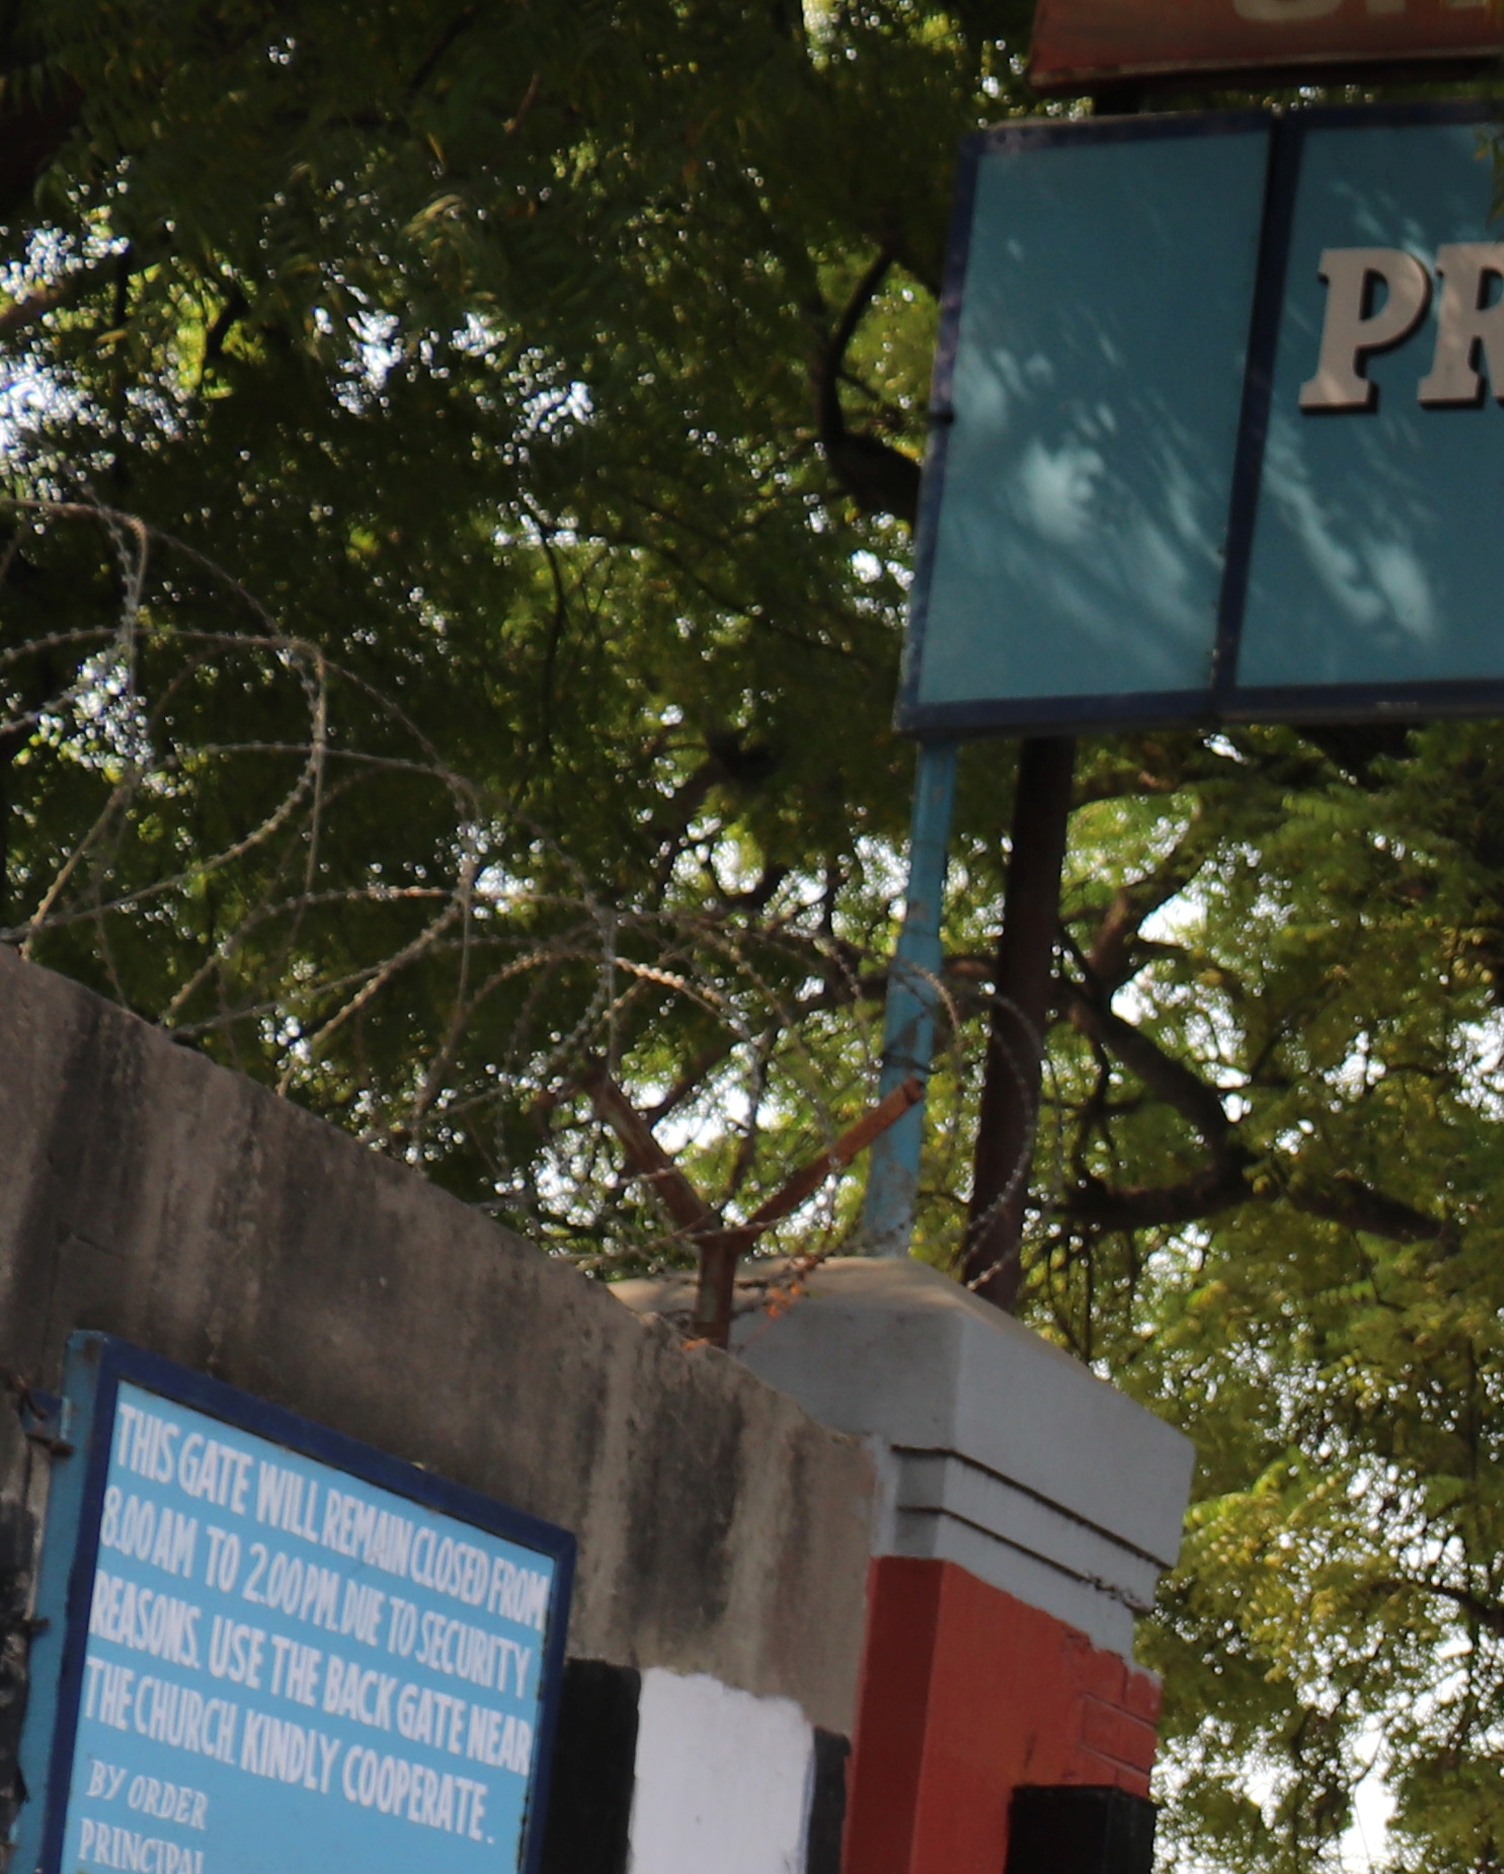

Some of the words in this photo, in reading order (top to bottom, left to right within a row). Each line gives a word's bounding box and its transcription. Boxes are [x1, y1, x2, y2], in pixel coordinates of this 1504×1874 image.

[117, 1402, 181, 1484] THIS
[178, 1432, 254, 1516] GATE
[256, 1460, 319, 1544] WILL
[320, 1487, 414, 1578] REMAIN
[410, 1525, 490, 1607] CLOSED
[487, 1556, 551, 1632] FROM
[205, 1524, 242, 1593] TO
[339, 1577, 386, 1647] DUE
[387, 1595, 418, 1658] TO
[414, 1609, 532, 1700] SECURITY
[85, 1656, 137, 1731] THE
[240, 1708, 342, 1795] KINDLY
[207, 1614, 269, 1690] USE
[270, 1634, 324, 1708] THE
[322, 1653, 398, 1732] BACK
[396, 1682, 467, 1755] GATE
[466, 1703, 534, 1777] NEAR
[86, 1758, 128, 1801] BY
[127, 1774, 209, 1831] ORDER
